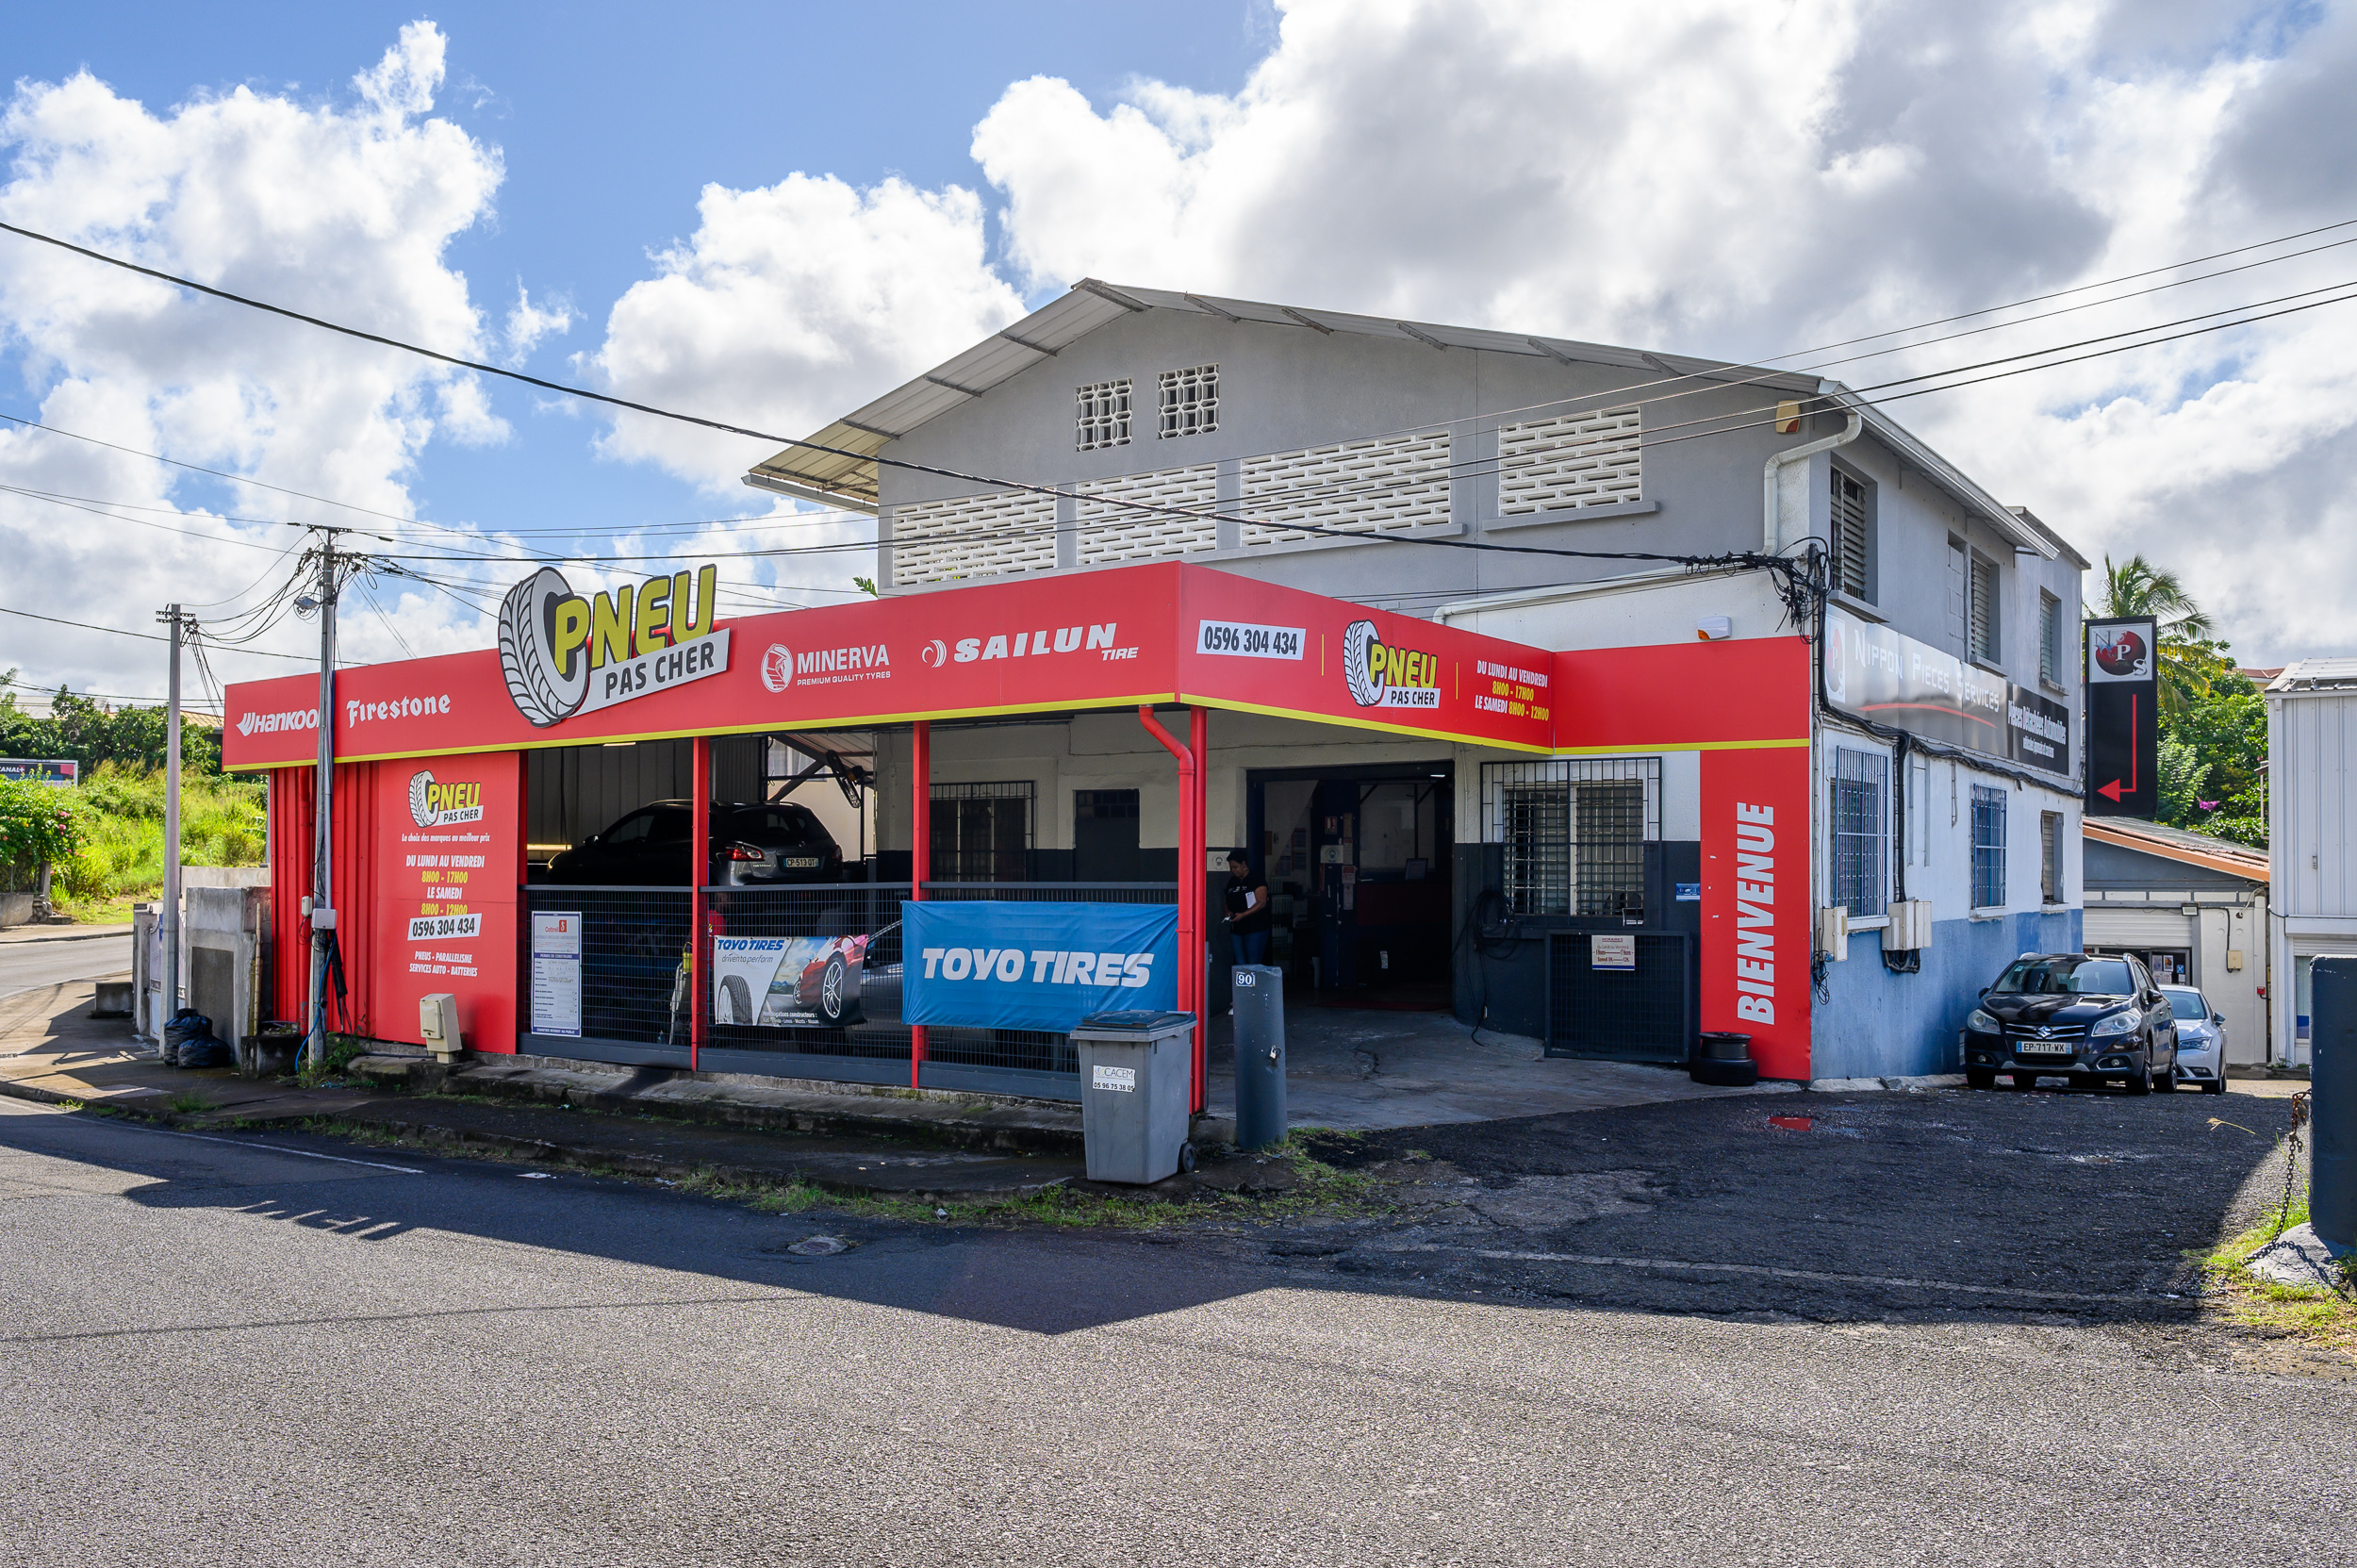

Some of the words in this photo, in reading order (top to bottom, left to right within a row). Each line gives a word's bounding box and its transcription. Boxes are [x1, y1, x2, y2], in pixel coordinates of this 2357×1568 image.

[554, 564, 717, 674] PNEU
[953, 622, 1117, 664] SAILUN
[1204, 625, 1240, 652] 0596
[1243, 629, 1269, 653] 304
[1273, 632, 1297, 655] 434
[797, 644, 890, 674] MINERVA
[1101, 646, 1139, 661] TIRE
[605, 662, 647, 700] PAS
[655, 641, 715, 684] CHER
[1369, 641, 1438, 689] PNEU
[797, 677, 831, 686] PREMIUM
[832, 673, 864, 684] QUALITY
[865, 670, 891, 681] TYRES
[1476, 660, 1487, 675] DU
[1488, 662, 1508, 679] LUNDI
[1508, 667, 1518, 682] AU
[1519, 668, 1548, 688] VENDREDI
[1391, 690, 1409, 705] PAS
[1411, 691, 1435, 705] CHER
[1492, 681, 1509, 697] 8H00
[1515, 685, 1534, 701] 17H00
[346, 694, 451, 729] Firestone
[1475, 695, 1483, 709] LE
[1483, 696, 1508, 714] SAMEDI
[1508, 701, 1525, 717] 8H00
[1530, 705, 1549, 721] 12H00
[427, 782, 481, 811] PNEU
[443, 812, 458, 823] PAS
[460, 809, 479, 820] CHER
[402, 834, 407, 842] Le
[407, 833, 420, 842] choix
[420, 833, 430, 842] des
[430, 834, 451, 844] marques
[458, 833, 479, 842] meilleur
[479, 833, 490, 844] prix
[405, 854, 416, 867] DU
[417, 855, 437, 867] LUNDI
[438, 855, 450, 867] AU
[451, 855, 485, 867] VENDREDI
[421, 870, 439, 883] 8H00
[447, 871, 468, 883] 17H00
[427, 887, 435, 899] LE
[436, 887, 462, 900] SAMEDI
[421, 902, 439, 916] 8H00
[446, 904, 468, 916] 12H00
[1737, 801, 1774, 1025] BIENVENUE
[412, 920, 435, 937] 0596
[437, 919, 454, 935] 304
[457, 917, 475, 934] 434
[717, 939, 749, 950] TOYO
[749, 939, 784, 950] TIRES
[414, 950, 431, 961] PNEUS
[435, 952, 472, 964] PARALLELISME
[721, 953, 740, 963] driven
[747, 955, 773, 965] perform
[409, 963, 432, 974] SERVICES
[432, 965, 447, 975] AUTO
[451, 966, 478, 977] BATTERIES
[922, 948, 1025, 982] TOYO
[1030, 949, 1155, 988] TIRES
[1238, 974, 1252, 984] 90
[2023, 1043, 2065, 1052] EP-717-WX
[1104, 1067, 1133, 1079] CACEM
